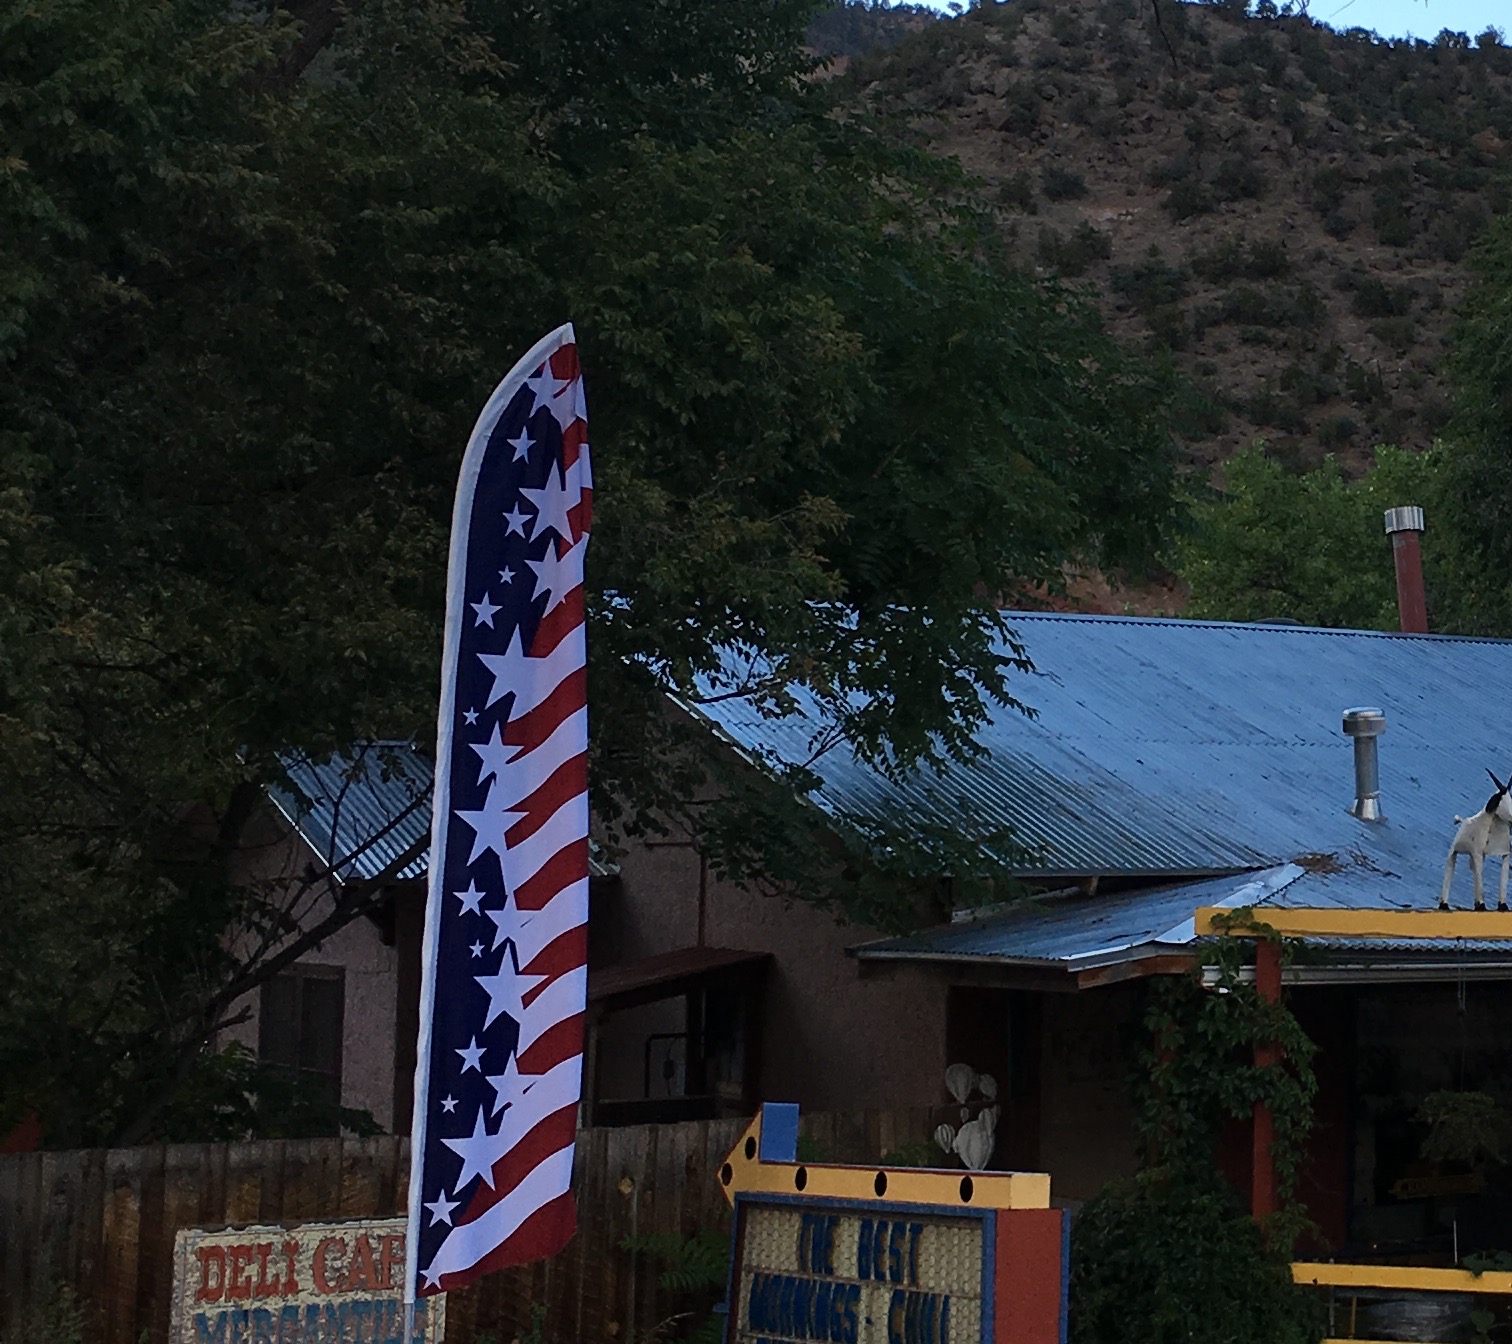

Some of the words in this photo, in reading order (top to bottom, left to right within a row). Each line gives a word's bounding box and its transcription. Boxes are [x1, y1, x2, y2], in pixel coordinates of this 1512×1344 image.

[195, 1240, 300, 1303] DELI
[312, 1233, 406, 1294] CAF
[799, 1213, 840, 1275] THE
[858, 1218, 923, 1286] BEST
